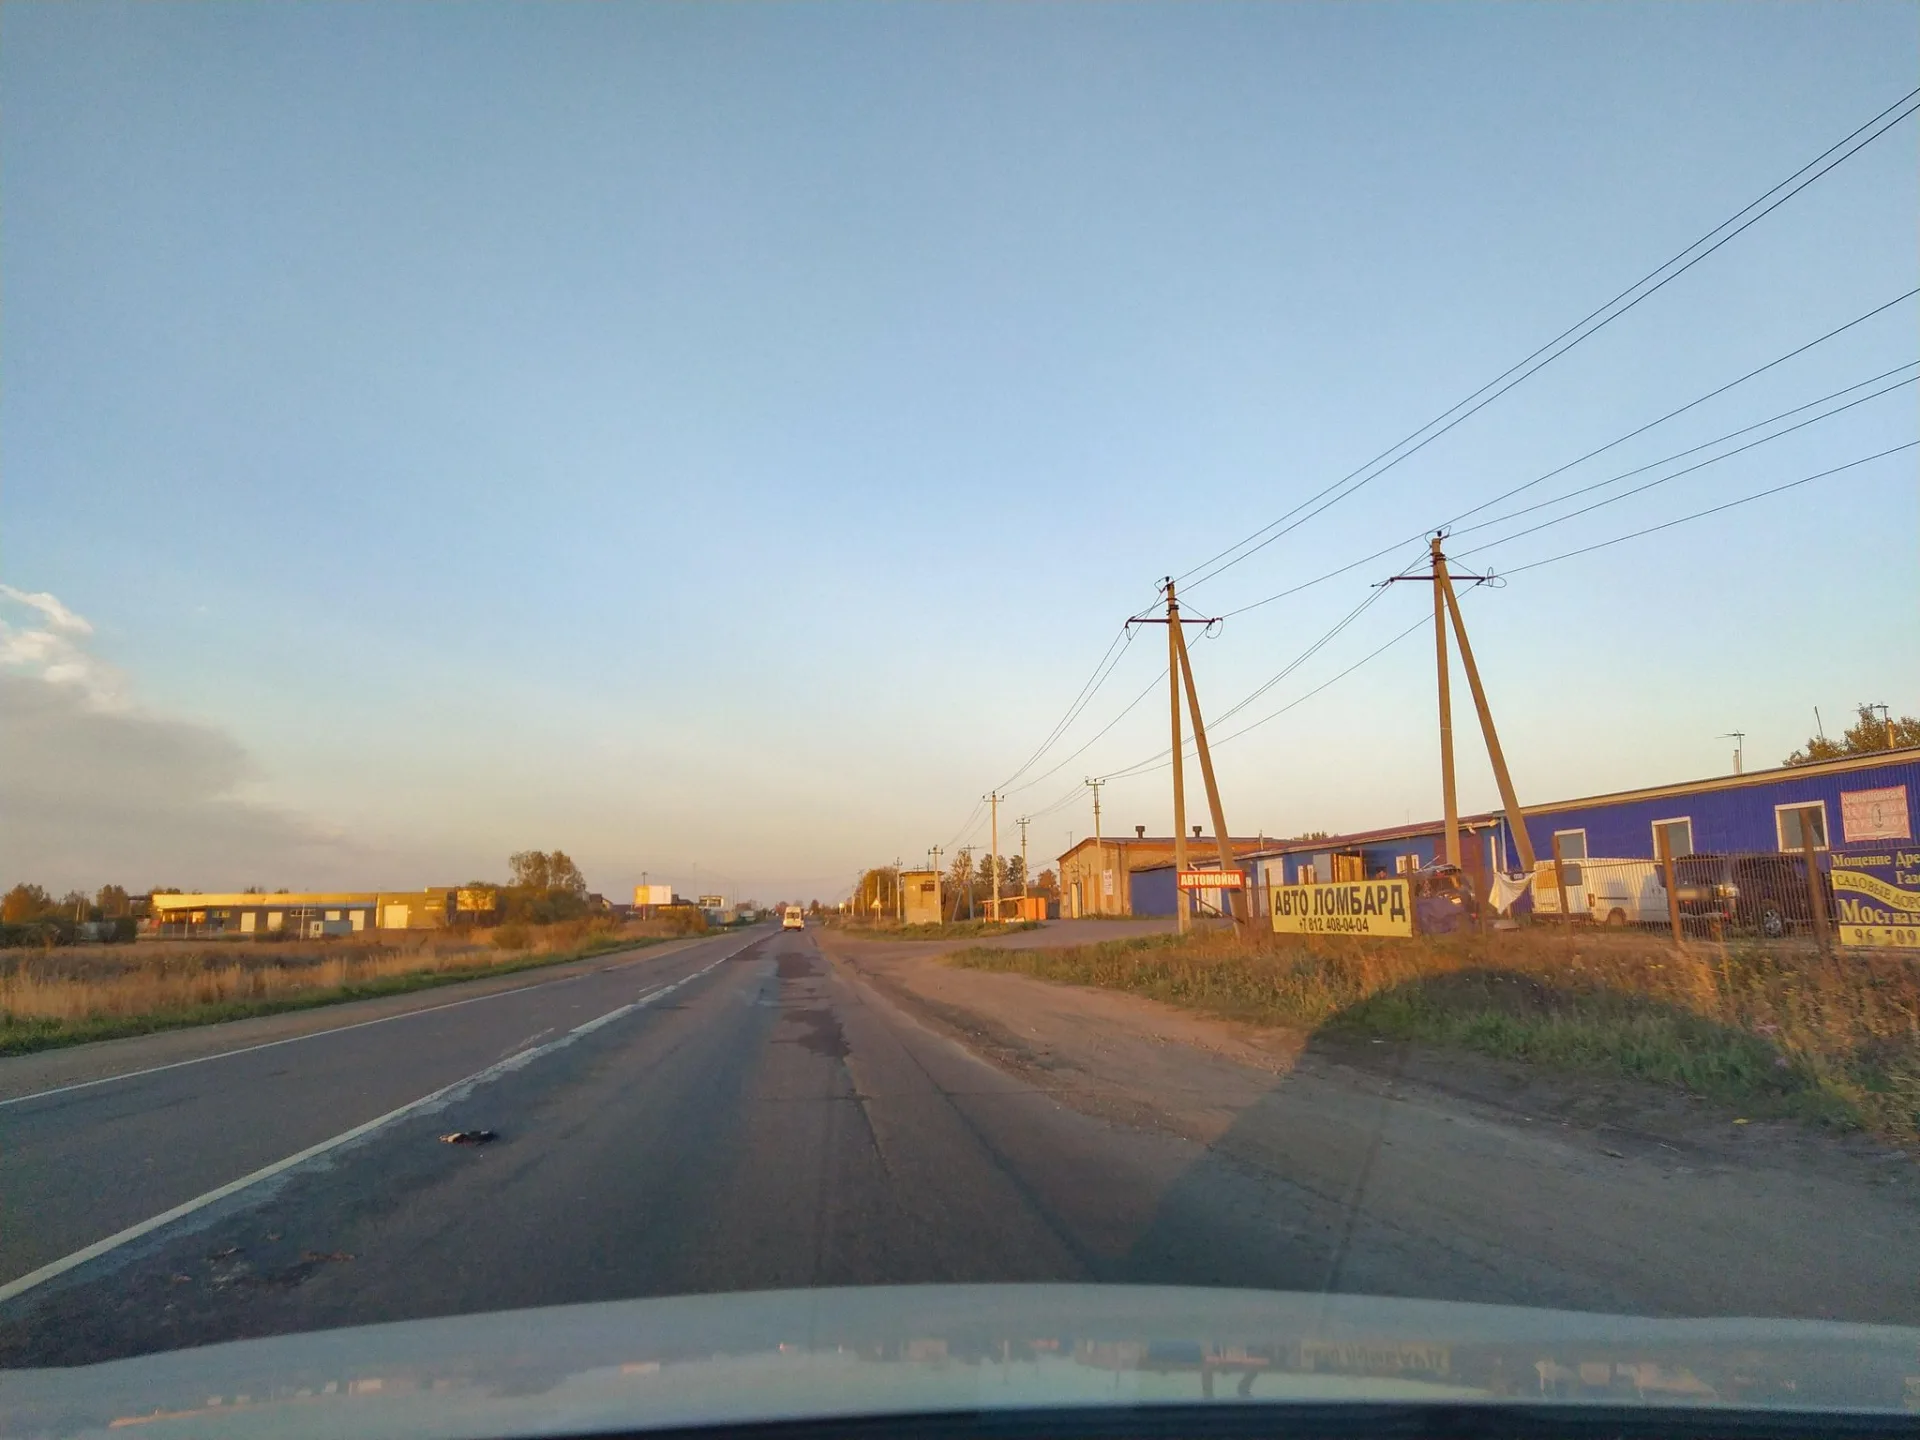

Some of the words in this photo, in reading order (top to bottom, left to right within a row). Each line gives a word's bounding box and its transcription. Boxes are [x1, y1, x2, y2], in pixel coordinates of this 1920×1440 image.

[1831, 854, 1892, 868] Мощение
[1180, 873, 1242, 886] АВТОМОЙКА
[1835, 875, 1892, 900] САДОВЫЕ
[1274, 887, 1309, 916] АВТО
[1313, 885, 1406, 922] ЛОМБАРД
[1308, 918, 1323, 931] 812
[1326, 917, 1369, 932] 408-04-04
